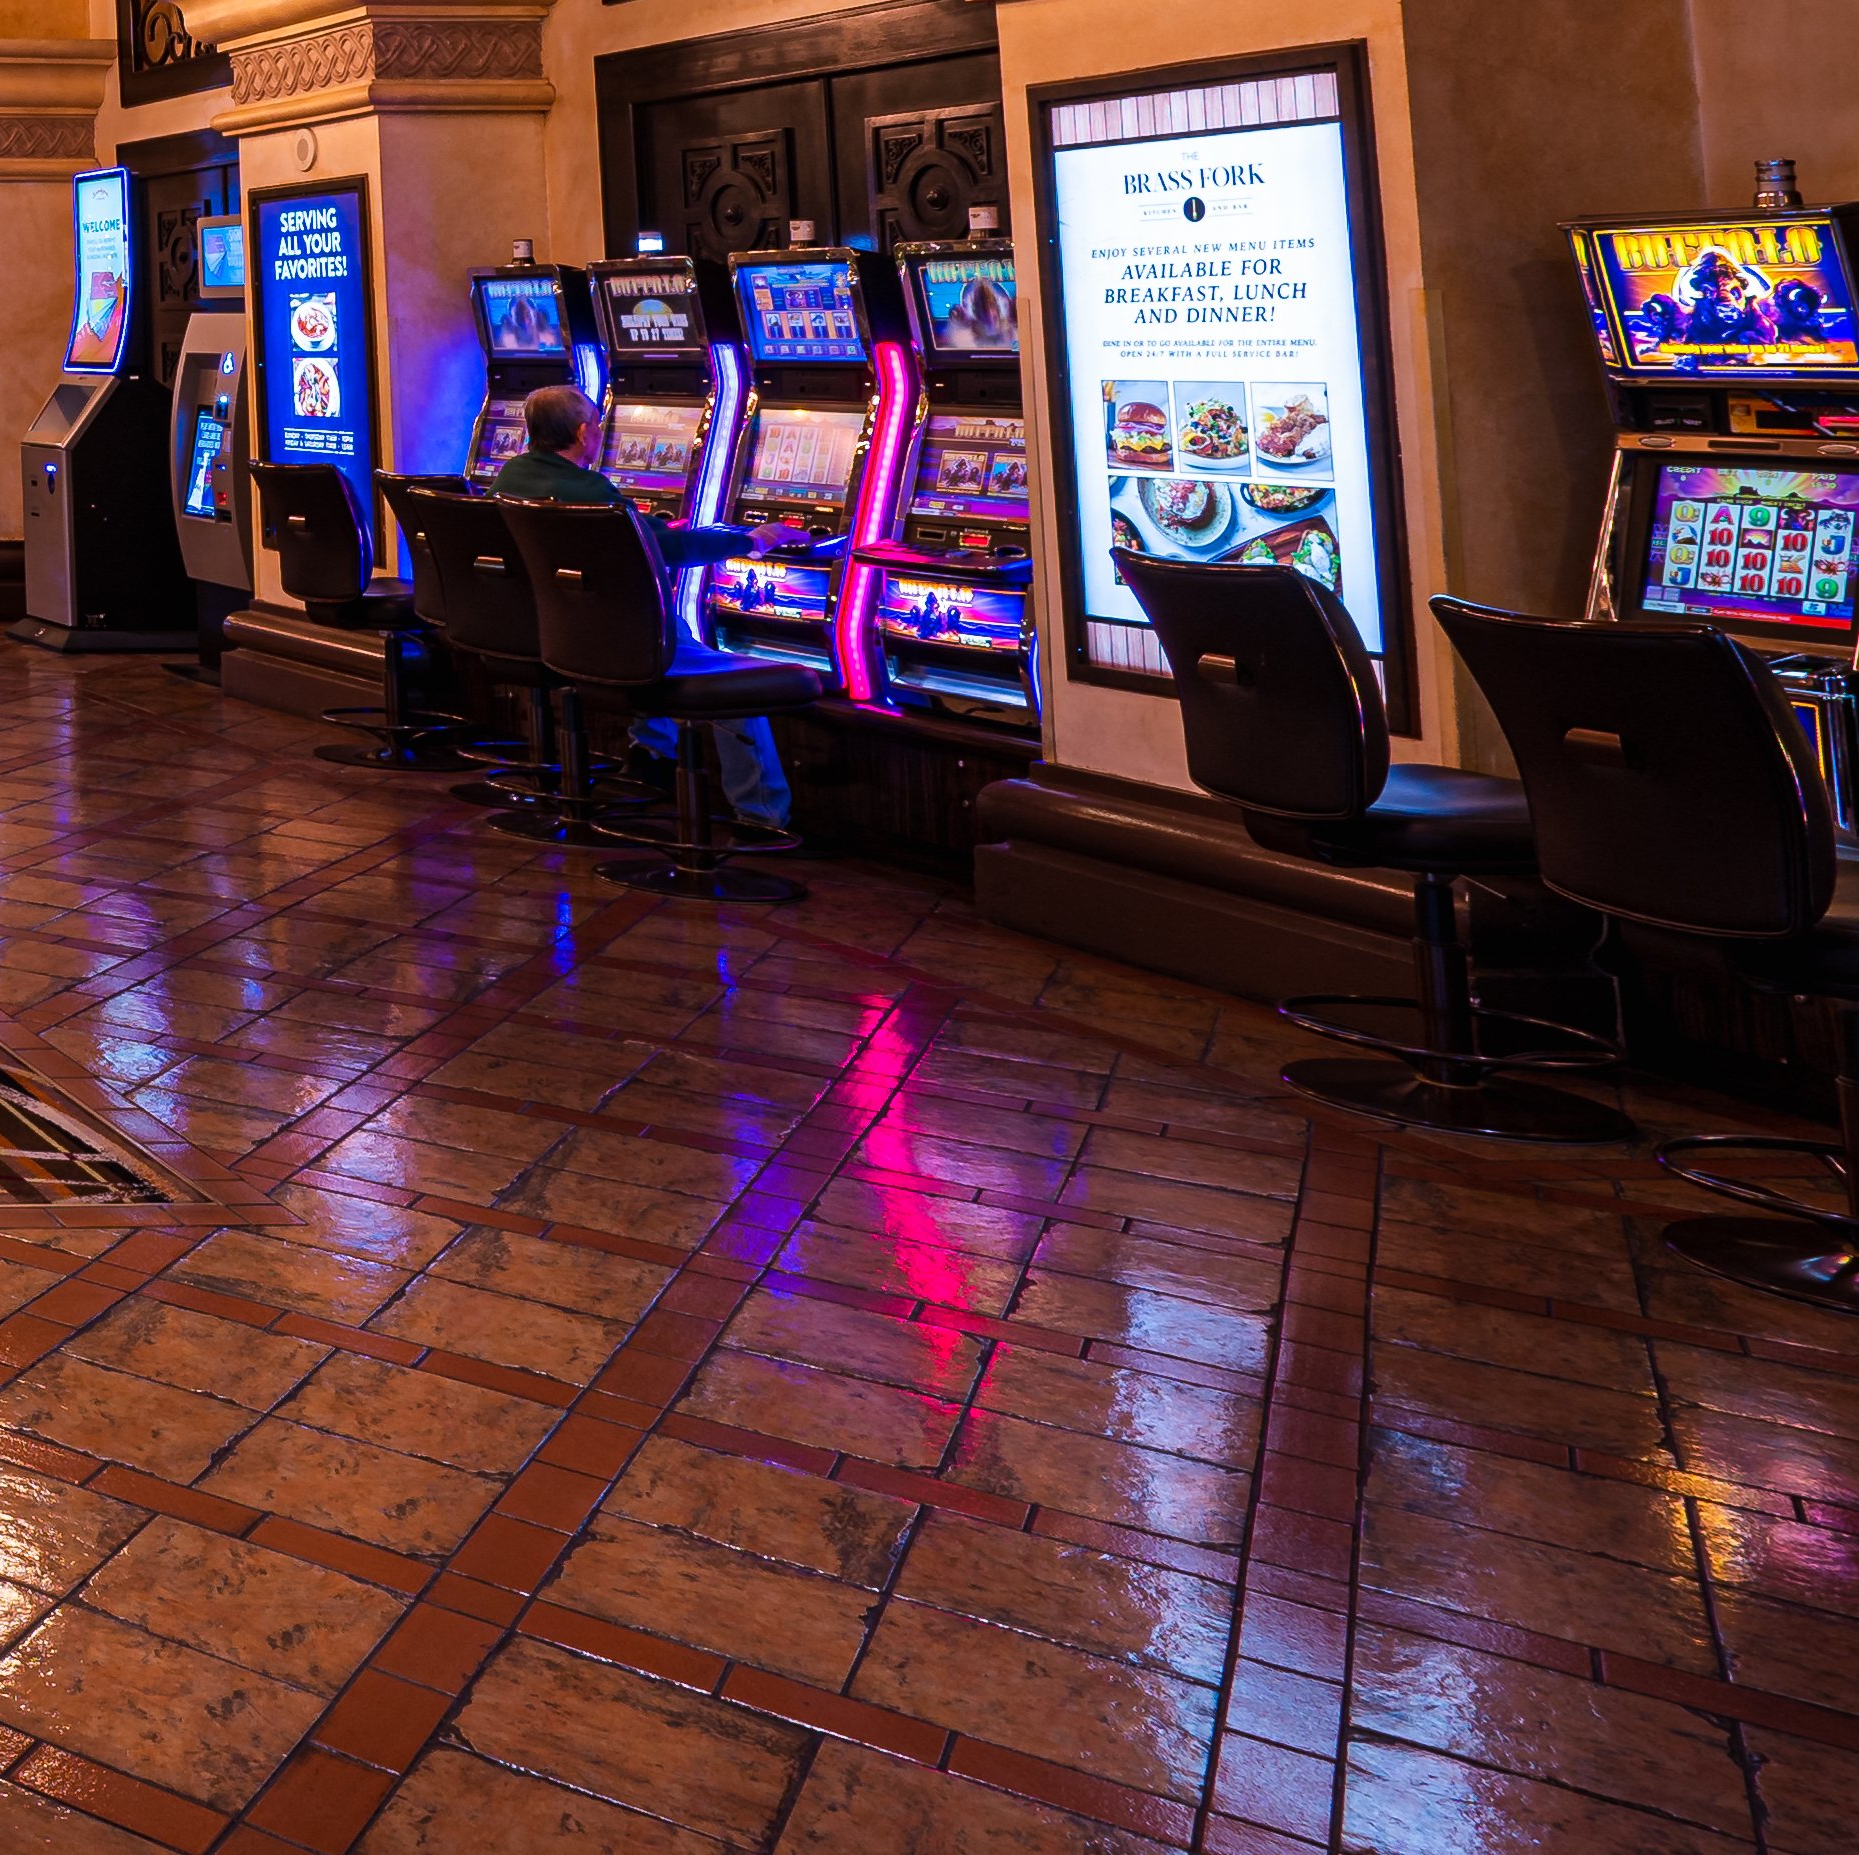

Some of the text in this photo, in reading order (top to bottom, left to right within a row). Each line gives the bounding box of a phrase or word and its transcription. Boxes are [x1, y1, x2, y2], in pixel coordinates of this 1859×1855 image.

[1181, 152, 1199, 161] THE
[1124, 163, 1265, 195] BRASS FORK
[280, 207, 337, 233] SERVING
[1143, 208, 1177, 216] KITCHEN
[82, 219, 121, 233] WELCOME
[278, 231, 341, 257] ALL YOUR
[1091, 238, 1315, 260] ENJOY SEVERAL NEW MENU ITEMS
[1612, 226, 1822, 271] BUFFALO
[275, 255, 348, 281] FAVORITES!
[1121, 258, 1282, 280] AVAILABLE FOR
[1104, 282, 1307, 304] BREAKFAST, LUNCH
[1134, 306, 1276, 324] AND DINNER!
[1120, 350, 1142, 358] OPEN
[1147, 350, 1164, 358] 24/7
[1169, 350, 1192, 358] WITH
[1205, 350, 1228, 358] FULL
[1232, 350, 1271, 358] SERVICE
[1123, 340, 1132, 348] IN
[1133, 340, 1144, 348] OR
[1147, 340, 1157, 348] TO
[1159, 340, 1170, 348] GO
[1256, 339, 1286, 347] ENTIRE
[1710, 506, 1734, 525] A
[1748, 507, 1771, 527] 9
[1708, 527, 1734, 547] 10
[1780, 533, 1808, 552] 10
[1705, 549, 1731, 568] 10
[1740, 552, 1768, 572] 10
[1739, 573, 1765, 593] 10
[1776, 577, 1803, 596] 10
[1815, 578, 1839, 599] 9
